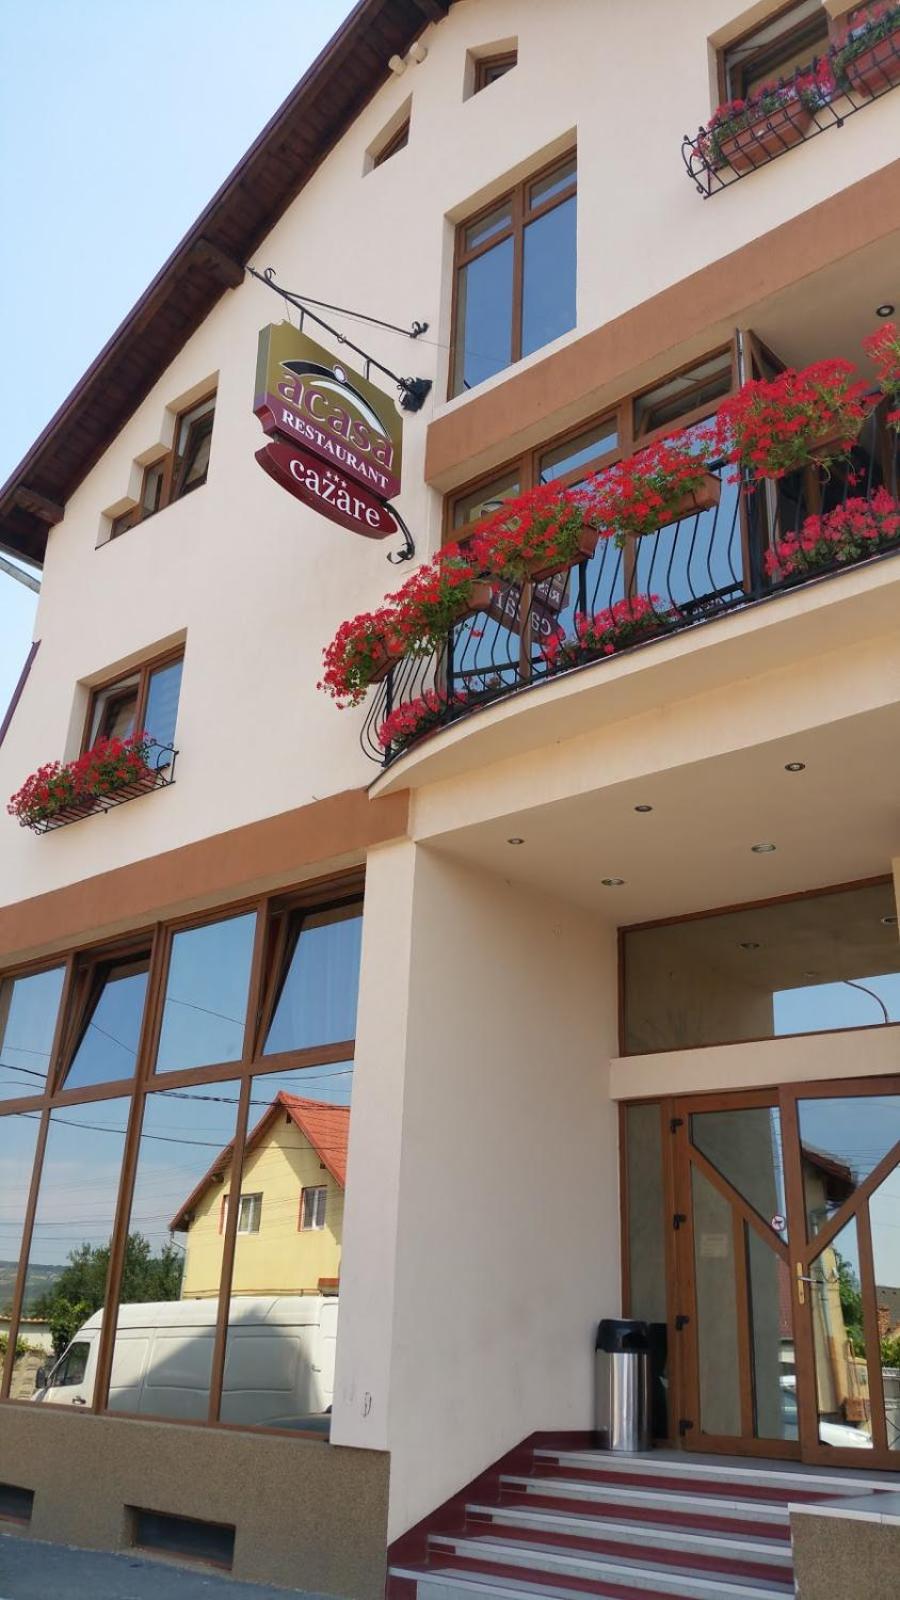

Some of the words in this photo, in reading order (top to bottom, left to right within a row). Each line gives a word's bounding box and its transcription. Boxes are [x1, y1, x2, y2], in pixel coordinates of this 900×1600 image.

[276, 373, 394, 471] acasa
[282, 409, 389, 489] RESTAURANT
[289, 459, 381, 528] cazare
